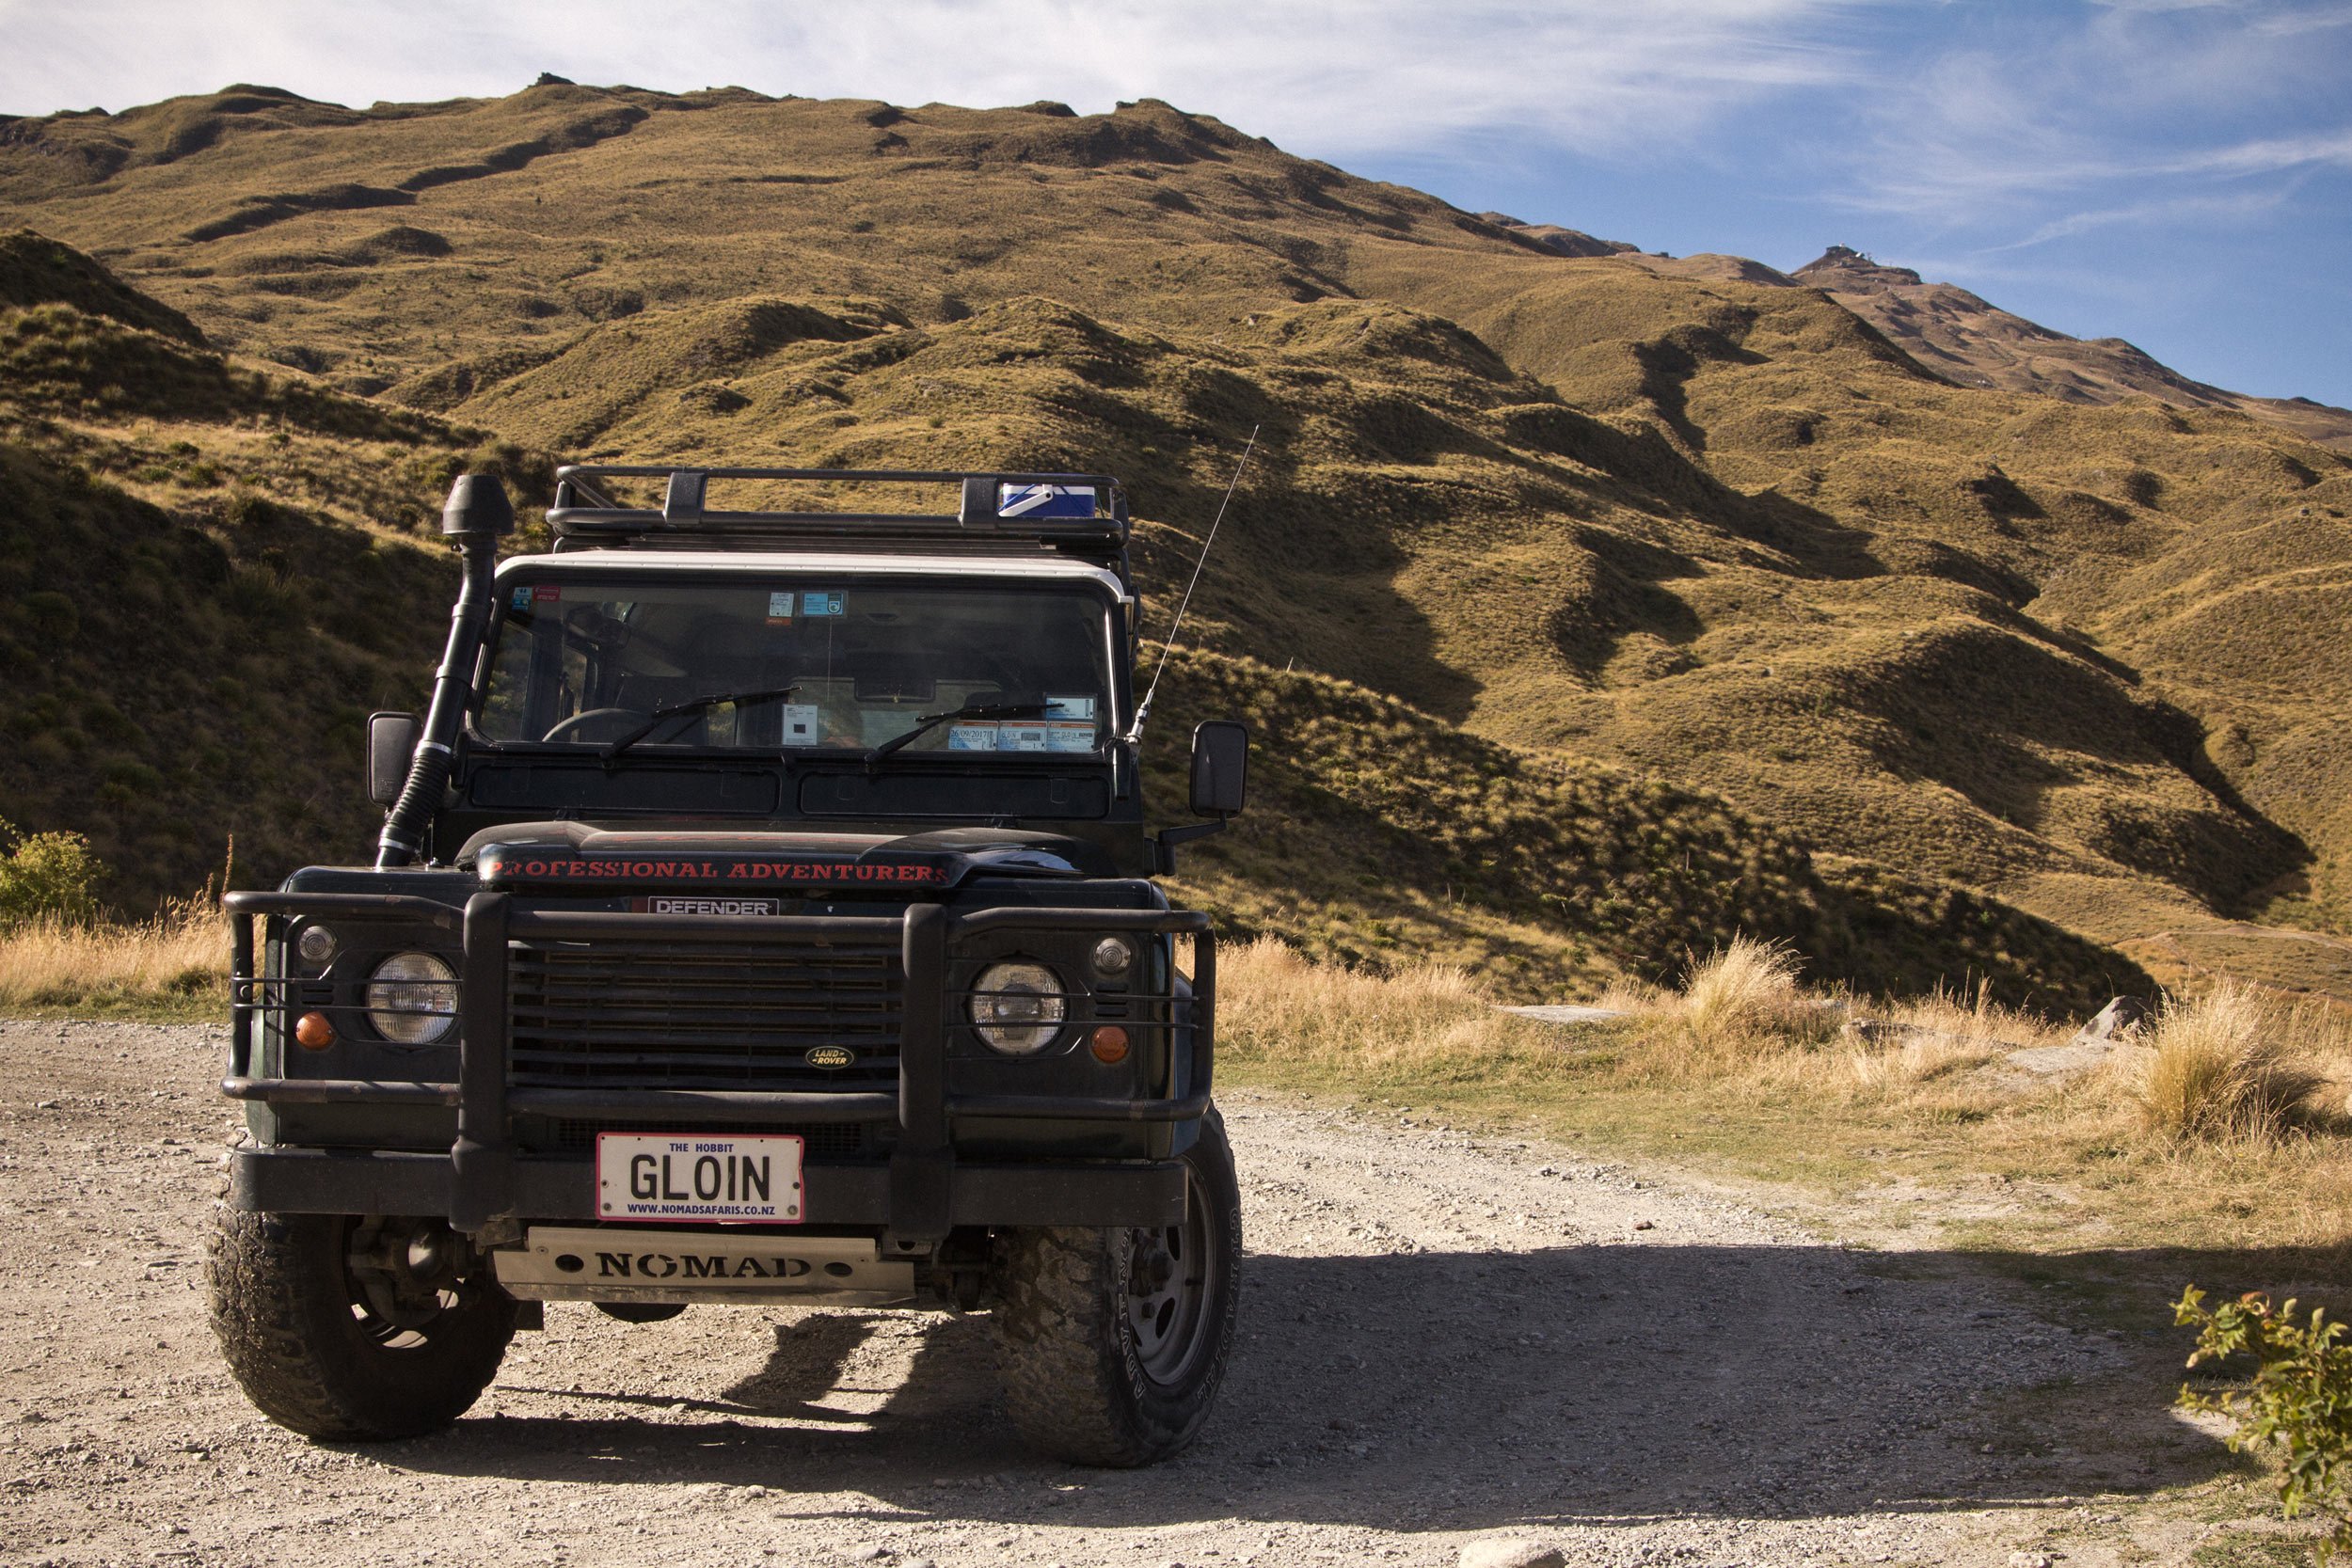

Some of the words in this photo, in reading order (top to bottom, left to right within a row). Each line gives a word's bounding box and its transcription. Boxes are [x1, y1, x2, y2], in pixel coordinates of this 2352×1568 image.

[727, 862, 949, 883] ADVENTURERS
[656, 899, 770, 916] DEFENDER
[815, 1049, 839, 1057] LAND
[669, 1143, 689, 1152] THE
[695, 1143, 734, 1153] HOBBIT
[630, 1154, 770, 1202] GLOIN
[628, 1204, 775, 1215] WWW.NOMADSAFARIS.CO.NZ
[595, 1252, 812, 1278] NOMAD
